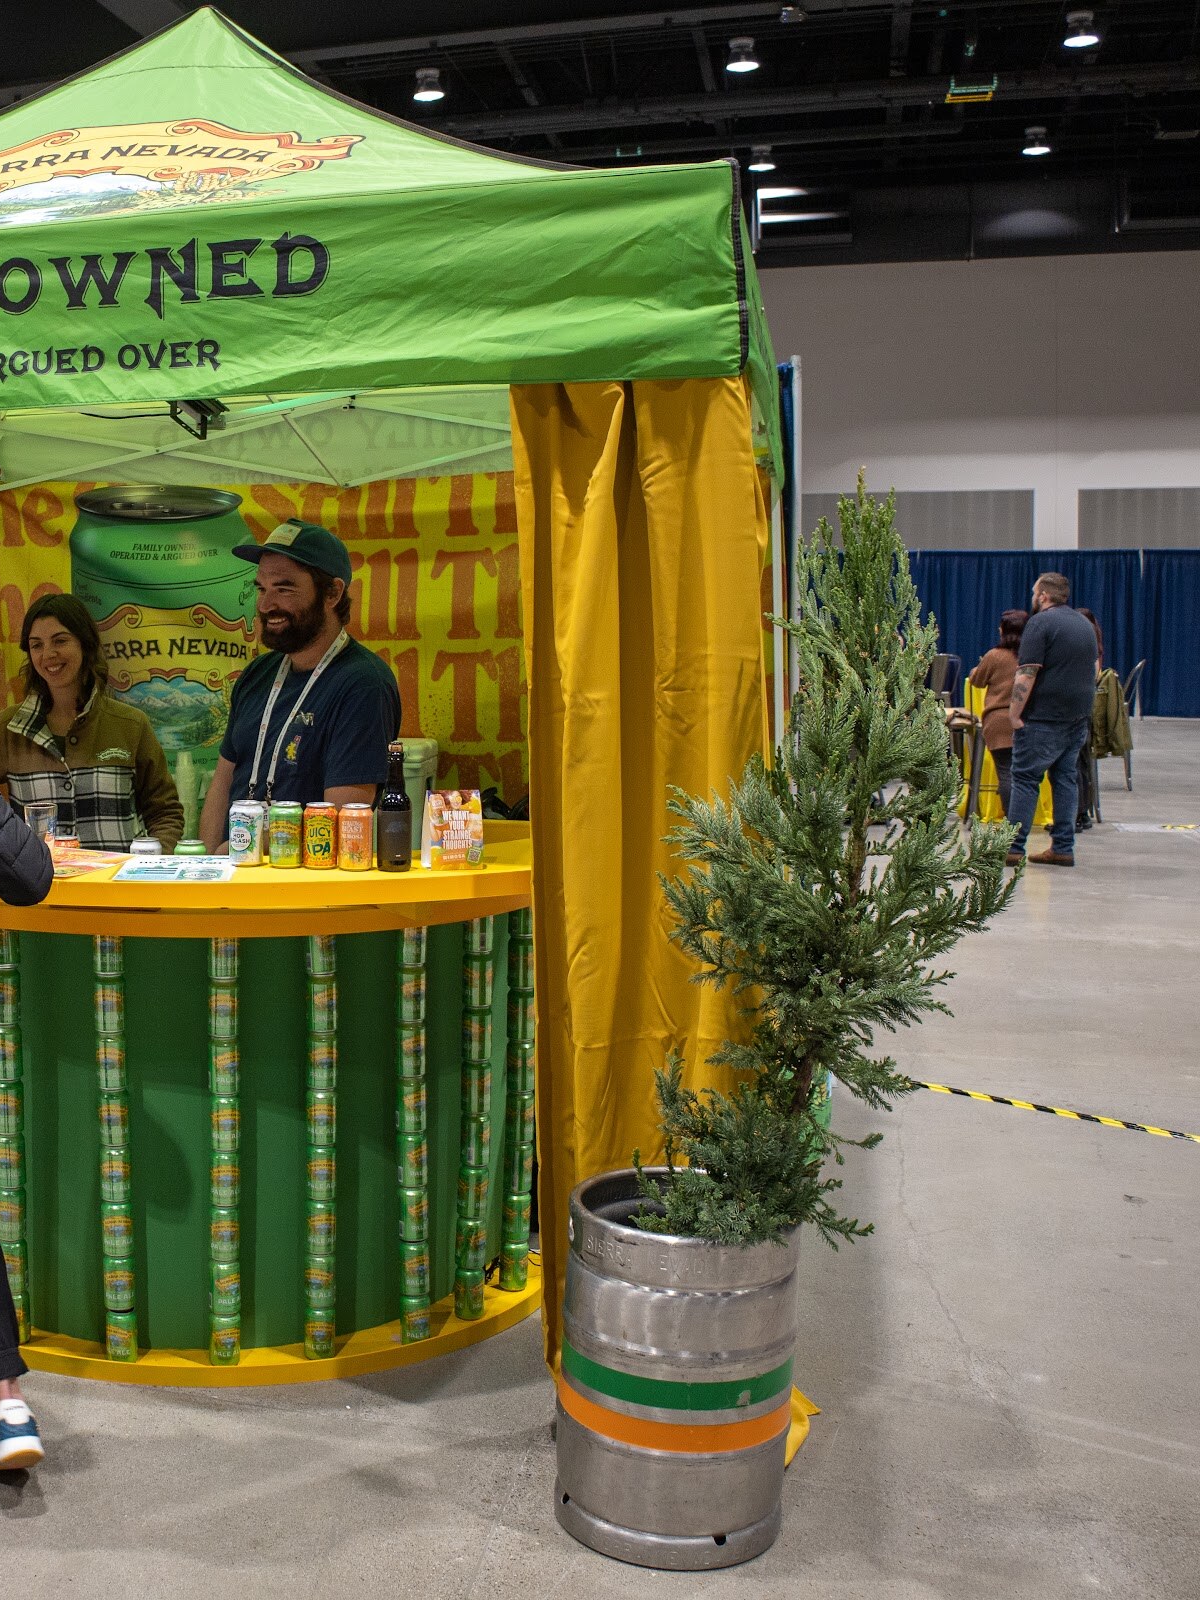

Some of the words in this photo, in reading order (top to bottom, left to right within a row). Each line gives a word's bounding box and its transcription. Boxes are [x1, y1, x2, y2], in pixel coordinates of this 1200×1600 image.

[100, 143, 277, 163] NEVADA
[117, 338, 222, 372] OVER
[132, 543, 164, 552] FAMILY
[109, 550, 151, 561] OPERATED
[151, 553, 160, 561] &
[160, 551, 196, 561] ARGUED
[197, 548, 220, 558] OVER
[103, 638, 160, 662] ERRA
[167, 636, 248, 661] NEVADA
[442, 811, 452, 821] WE
[452, 811, 470, 821] WANT
[448, 820, 465, 830] YOUR
[307, 826, 331, 839] JUICY
[306, 842, 331, 856] IPA
[442, 839, 473, 849] THOUGHTS
